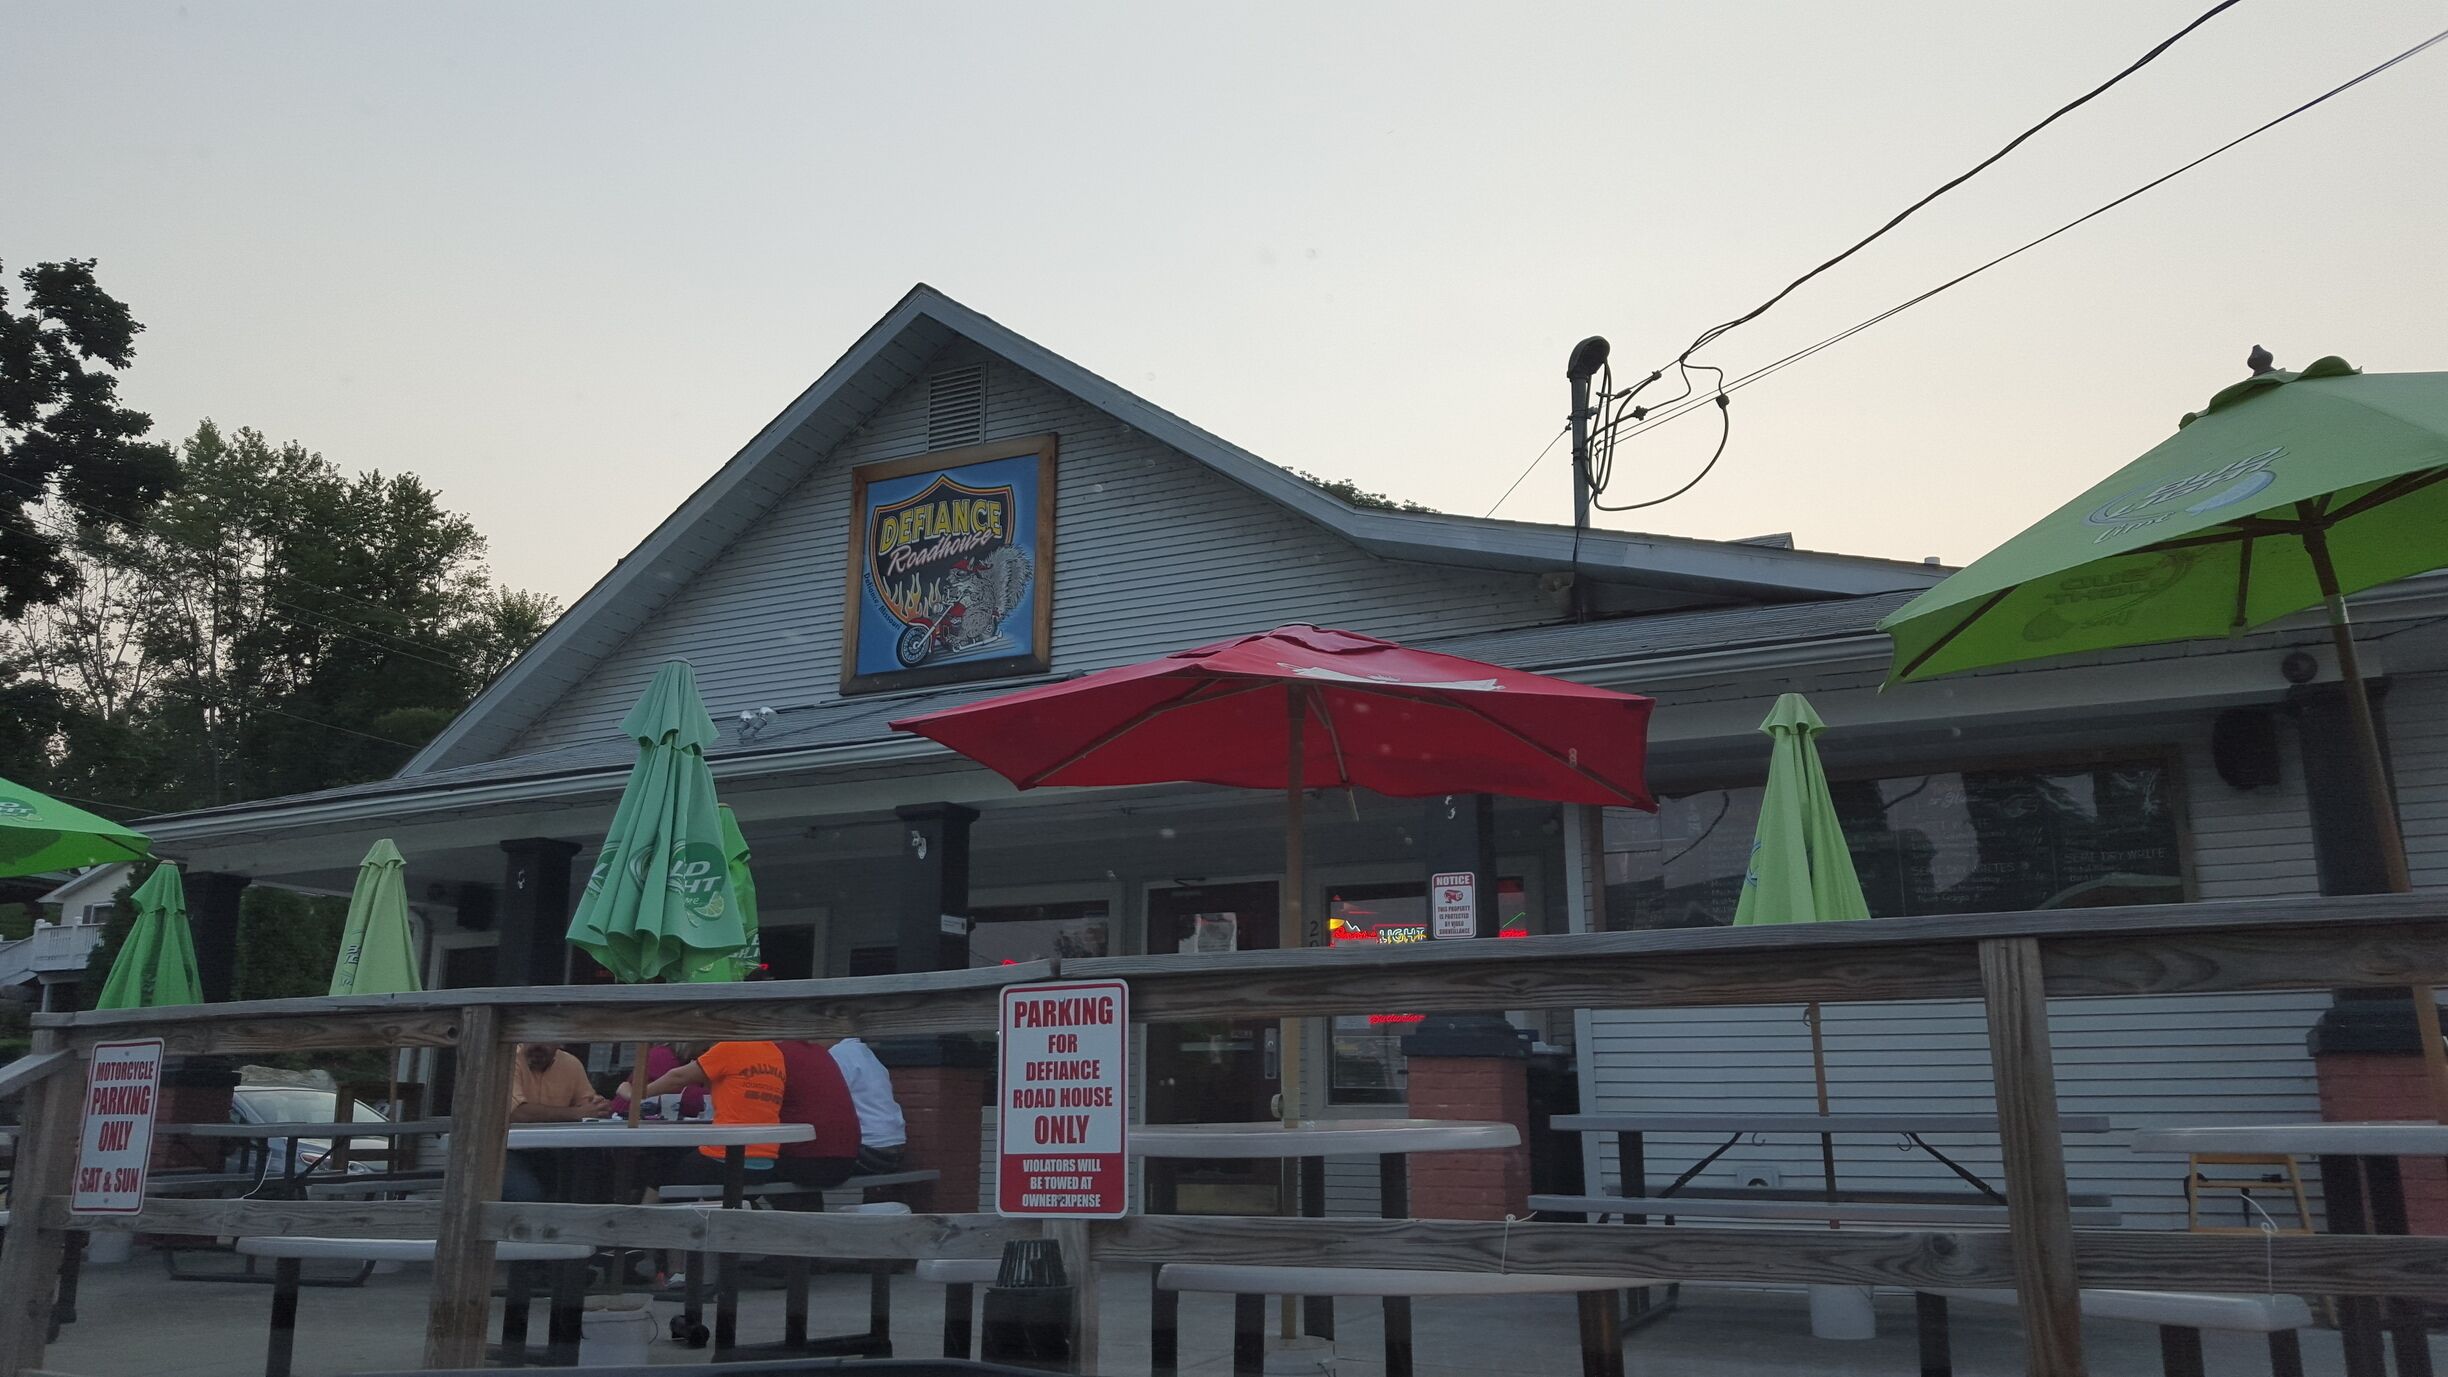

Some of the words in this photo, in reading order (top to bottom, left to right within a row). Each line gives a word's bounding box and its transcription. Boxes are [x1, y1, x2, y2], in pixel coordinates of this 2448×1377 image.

[879, 500, 1003, 556] DEFIANCE
[887, 529, 994, 576] Roadhouse
[1436, 875, 1470, 886] NOTICE
[1014, 996, 1114, 1028] PARKING
[1048, 1034, 1078, 1053] FOR
[96, 1061, 154, 1081] MOTORCYCLE
[1026, 1060, 1100, 1081] DEFIANCE
[90, 1085, 151, 1115] PARKING
[1013, 1088, 1055, 1108] ROAD
[1060, 1087, 1113, 1107] HOUSE
[97, 1120, 133, 1152] ONLY
[1034, 1115, 1090, 1144] ONLY
[1023, 1159, 1076, 1172] VIOLATORS
[1078, 1158, 1102, 1172] WILL
[79, 1167, 103, 1193] SAT
[103, 1171, 112, 1193] &
[113, 1168, 140, 1193] SUN
[1030, 1176, 1042, 1190] BE
[1044, 1176, 1079, 1190] TOWED
[1080, 1176, 1093, 1190] AT
